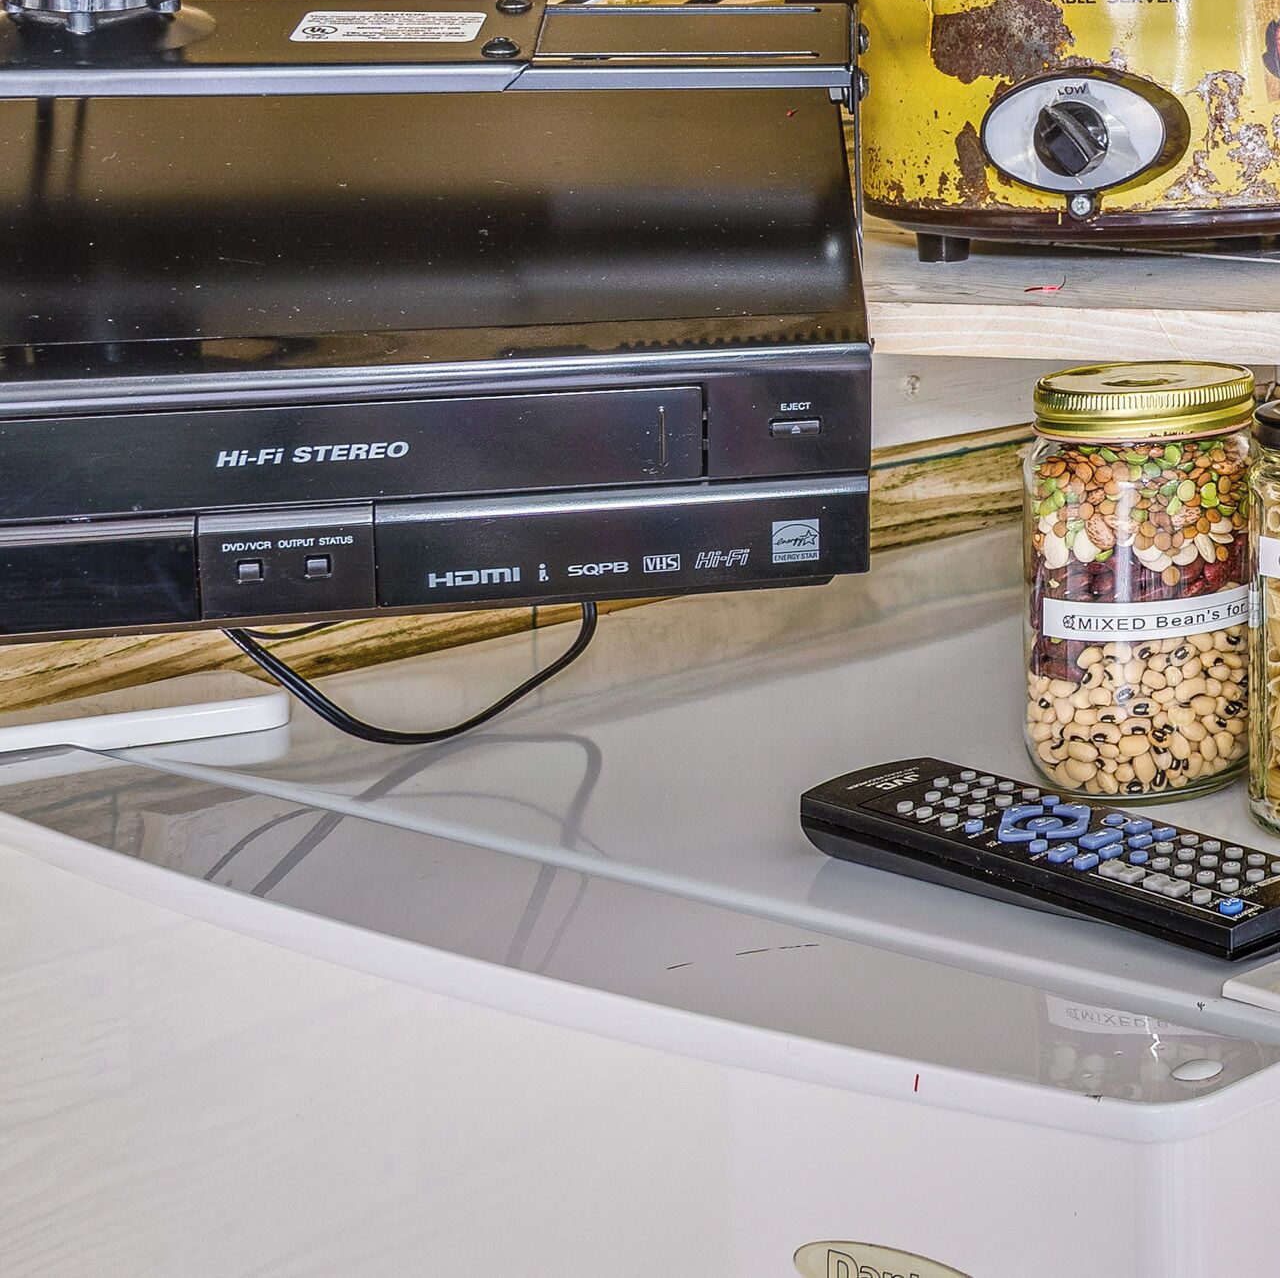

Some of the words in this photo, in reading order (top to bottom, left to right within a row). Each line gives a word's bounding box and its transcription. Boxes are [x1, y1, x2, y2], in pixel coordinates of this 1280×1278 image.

[1057, 83, 1087, 96] LOW
[780, 401, 812, 411] EJECT
[216, 447, 285, 468] Hi-Fi
[292, 441, 410, 463] STEREO
[221, 540, 272, 552] DVD/VCR
[277, 537, 315, 549] OUTPUT
[318, 535, 354, 546] STATUS
[645, 555, 680, 571] VHS
[695, 548, 751, 569] Hi-Fi
[773, 553, 801, 562] ENERGY
[801, 552, 818, 560] STAR
[567, 560, 630, 577] SQPB
[428, 567, 521, 588] HDMI
[1078, 617, 1146, 631] MIXED
[1156, 610, 1221, 629] Bean's
